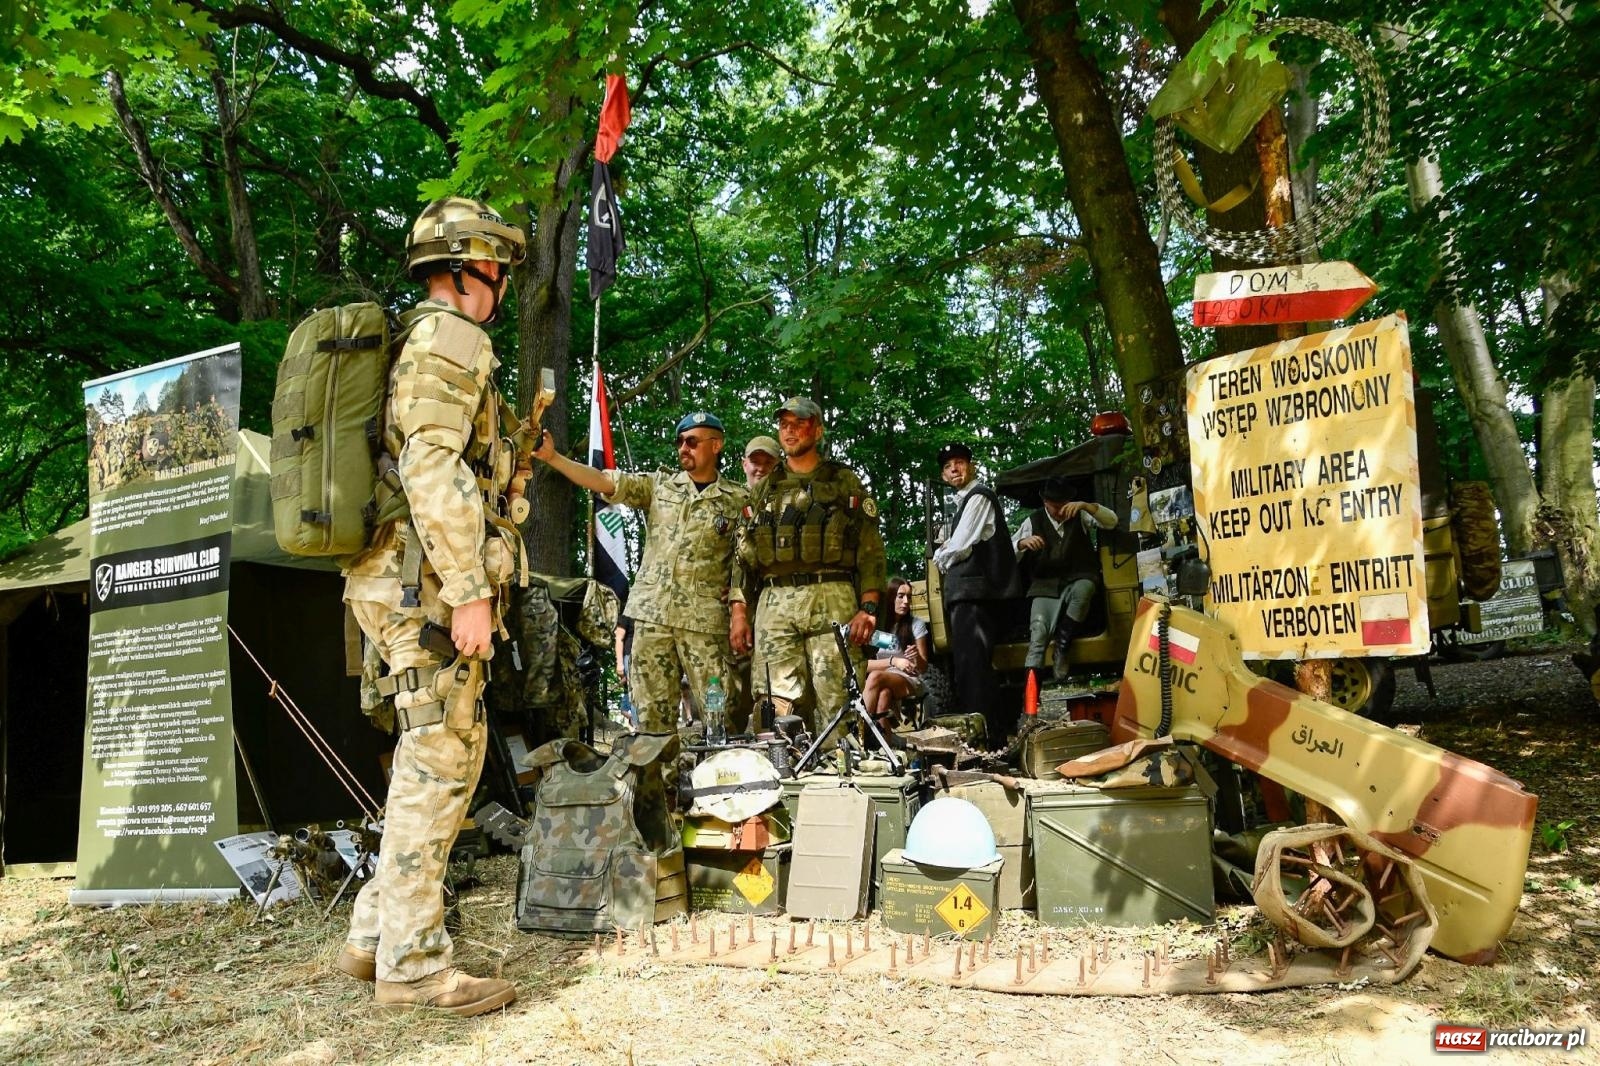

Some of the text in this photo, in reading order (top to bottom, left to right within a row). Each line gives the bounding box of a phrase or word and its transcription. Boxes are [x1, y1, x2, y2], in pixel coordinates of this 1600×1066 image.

[1230, 271, 1288, 295] DOM
[1208, 336, 1377, 401] TEREN WOJSKOWY
[1203, 374, 1391, 440] WSTĘP WZBRONIONY
[1231, 449, 1369, 499] MILITARY AREA
[1209, 507, 1250, 540] KEEP
[1260, 500, 1292, 533] OUT
[1340, 483, 1402, 522] ENTRY
[115, 547, 220, 580] RANGER SURVIVAL CLUB
[1330, 554, 1414, 594] EINTRITT
[1500, 575, 1534, 590] CLUB
[1262, 602, 1357, 638] VERBOTEN
[1138, 651, 1198, 695] CIMIC
[1291, 724, 1344, 759] العراق
[953, 896, 972, 910] 1.4
